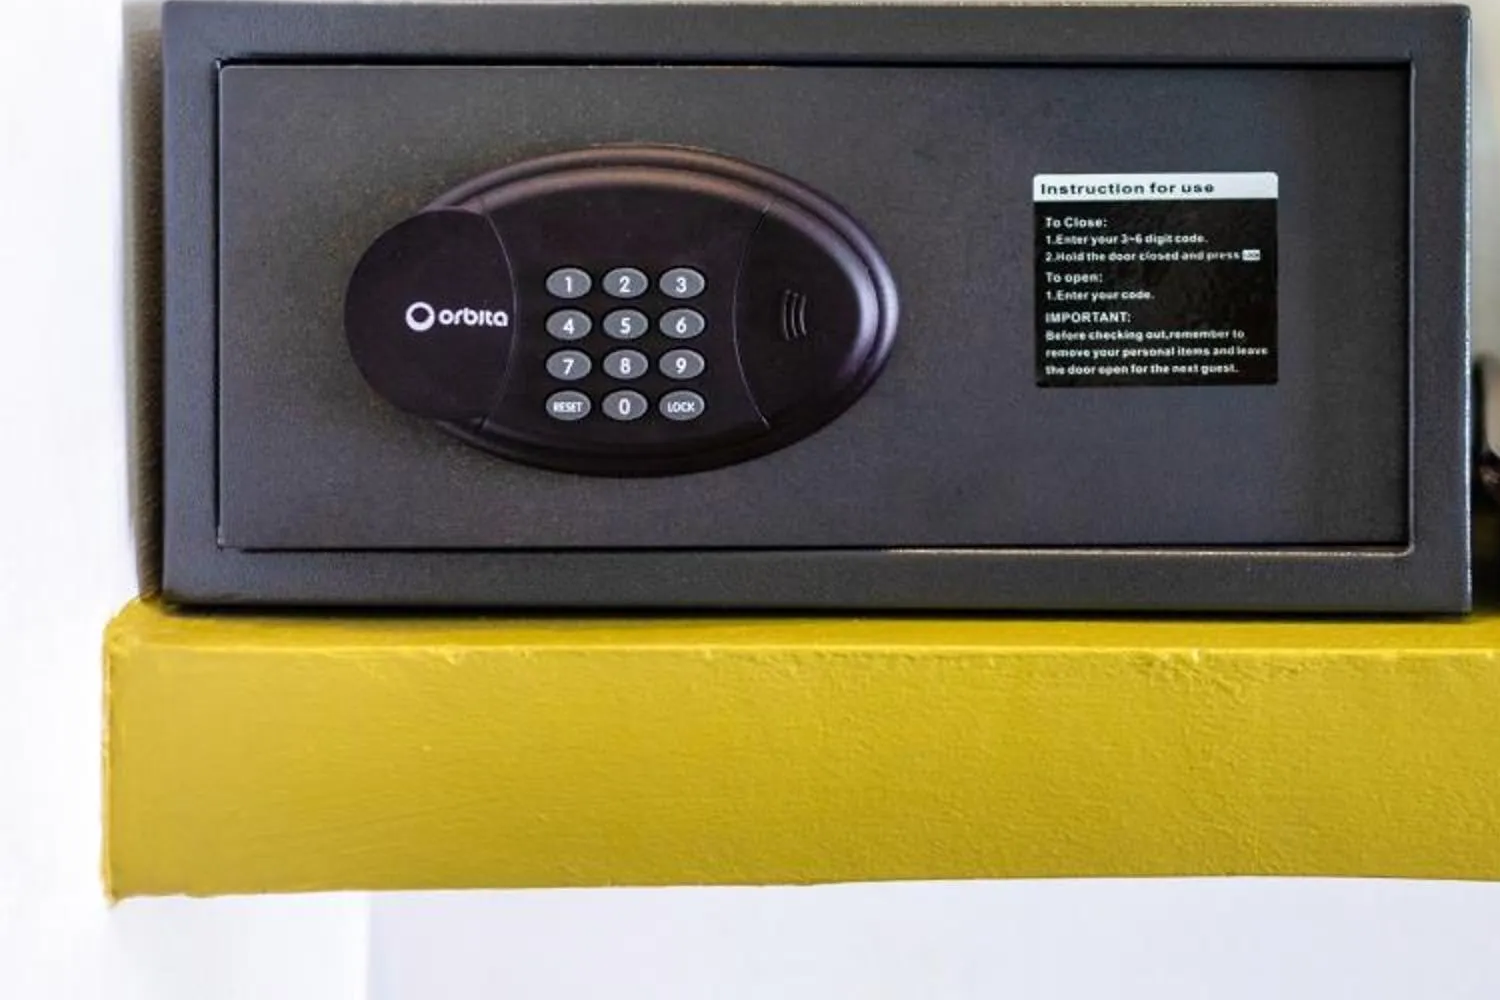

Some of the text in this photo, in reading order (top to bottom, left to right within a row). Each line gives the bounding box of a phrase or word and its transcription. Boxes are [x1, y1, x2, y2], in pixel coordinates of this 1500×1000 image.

[1040, 182, 1214, 195] Instruction for use
[1045, 216, 1108, 228] To Close:
[1045, 234, 1089, 245] 1.Enter
[1090, 235, 1119, 247] your
[1145, 234, 1173, 246] digit
[1174, 234, 1208, 243] code.
[1045, 251, 1085, 262] 2.Hold
[1086, 251, 1106, 261] the
[1107, 251, 1136, 261] door
[1139, 250, 1179, 261] closed
[1181, 250, 1205, 261] and
[1206, 251, 1241, 262] press
[565, 275, 688, 293] 1 2 3
[1045, 272, 1104, 285] To open:
[1045, 290, 1156, 303] 1.Enter your code.
[438, 307, 509, 327] orbita
[1045, 311, 1131, 323] IMPORTANT:
[562, 317, 688, 334] 4 5 6
[1045, 330, 1086, 342] Before
[1087, 330, 1144, 342] checking
[1231, 329, 1246, 339] to
[1045, 345, 1269, 360] remove your personal items and leave
[562, 357, 688, 375] 7 8 9
[1045, 365, 1066, 376] the
[1067, 364, 1097, 375] door
[1098, 365, 1129, 377] open
[1130, 364, 1149, 374] for
[1150, 363, 1170, 374] the
[1171, 363, 1199, 374] next
[553, 398, 695, 415] RESET 0 LOCK
